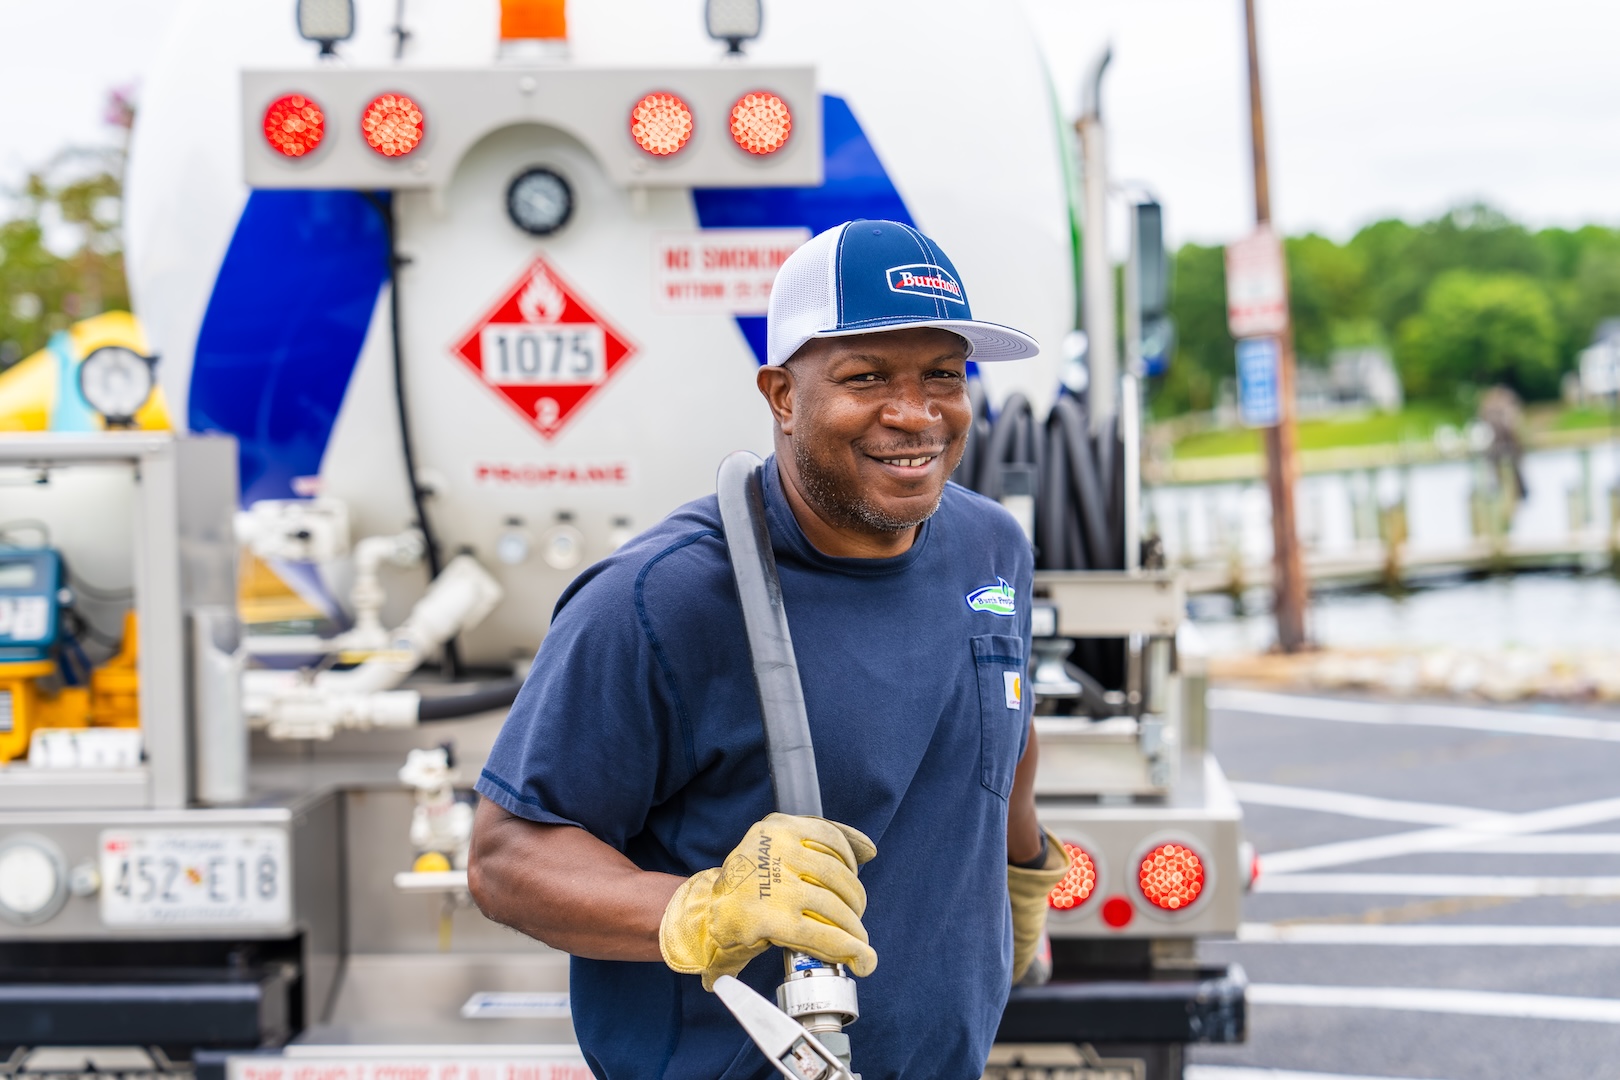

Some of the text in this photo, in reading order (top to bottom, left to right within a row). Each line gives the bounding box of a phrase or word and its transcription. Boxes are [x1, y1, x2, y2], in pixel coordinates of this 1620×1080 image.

[664, 247, 690, 270] NO
[496, 332, 595, 378] 1075
[534, 396, 560, 428] 2
[475, 463, 627, 485] PROPANE
[772, 857, 782, 884] 865XL
